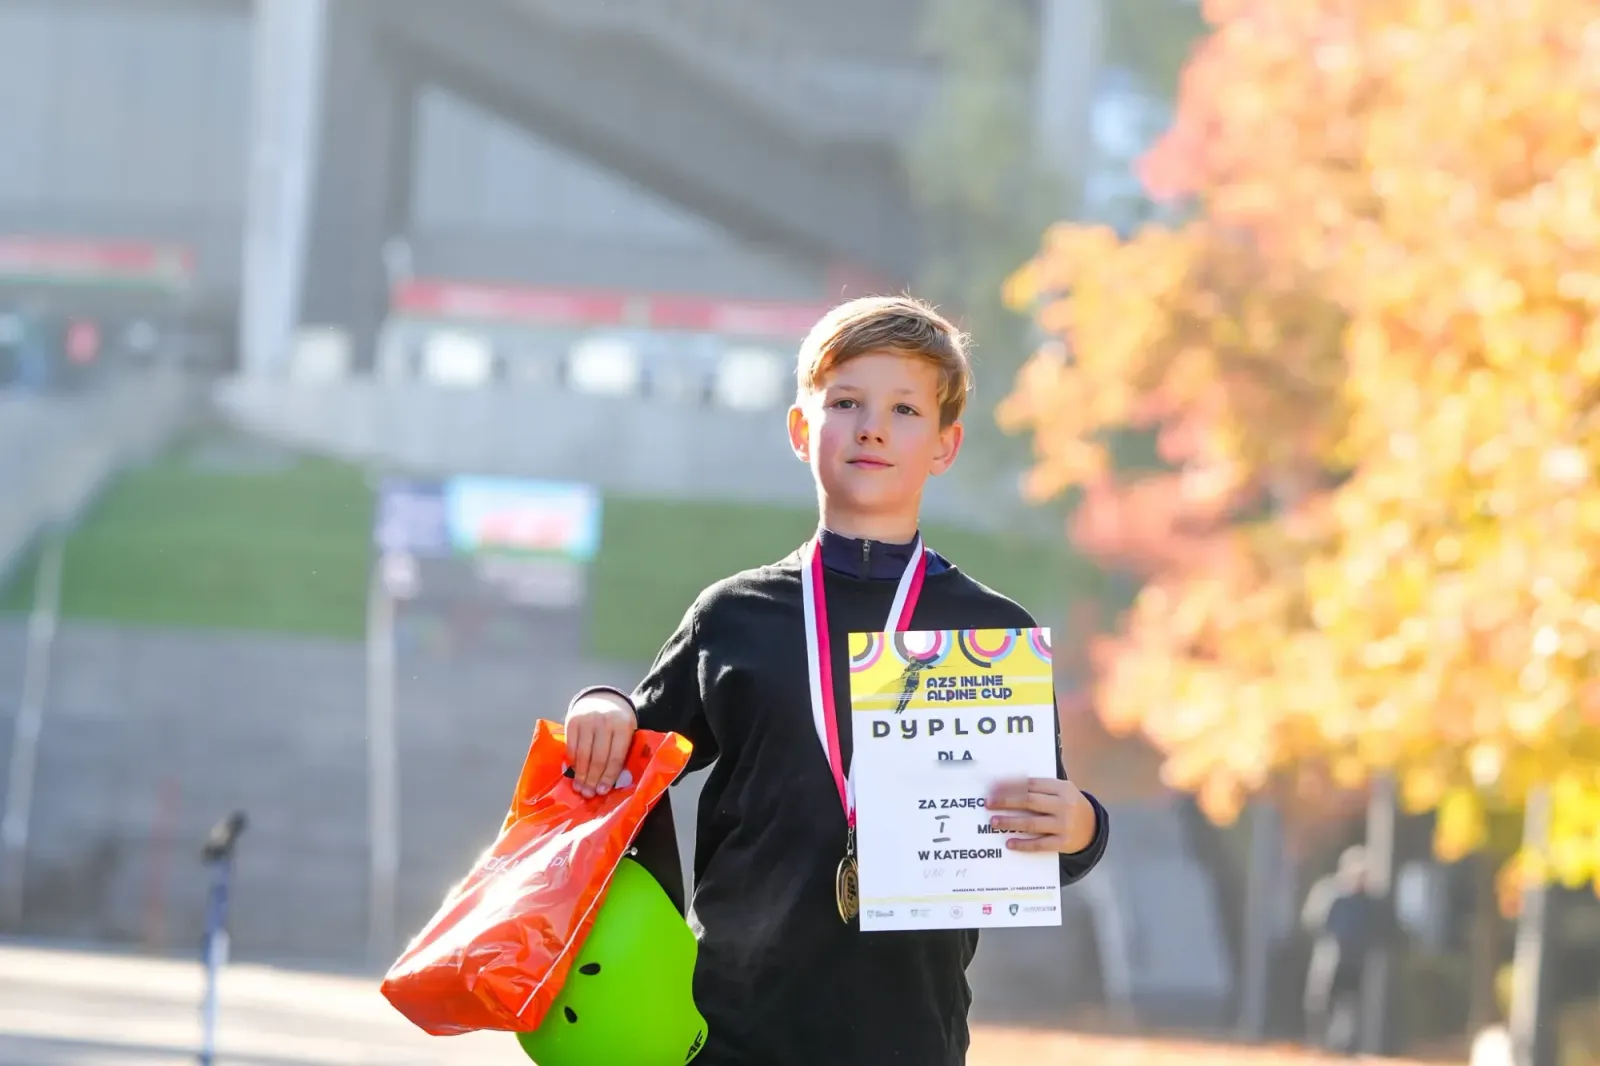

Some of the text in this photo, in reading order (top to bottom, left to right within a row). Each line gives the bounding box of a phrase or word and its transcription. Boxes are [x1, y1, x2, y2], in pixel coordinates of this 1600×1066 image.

[926, 675, 1003, 689] AZS INLINE
[927, 687, 1012, 702] ALPINE CUP
[918, 798, 986, 810] ZA ZAJĘC
[918, 849, 1002, 861] W KATEGORII
